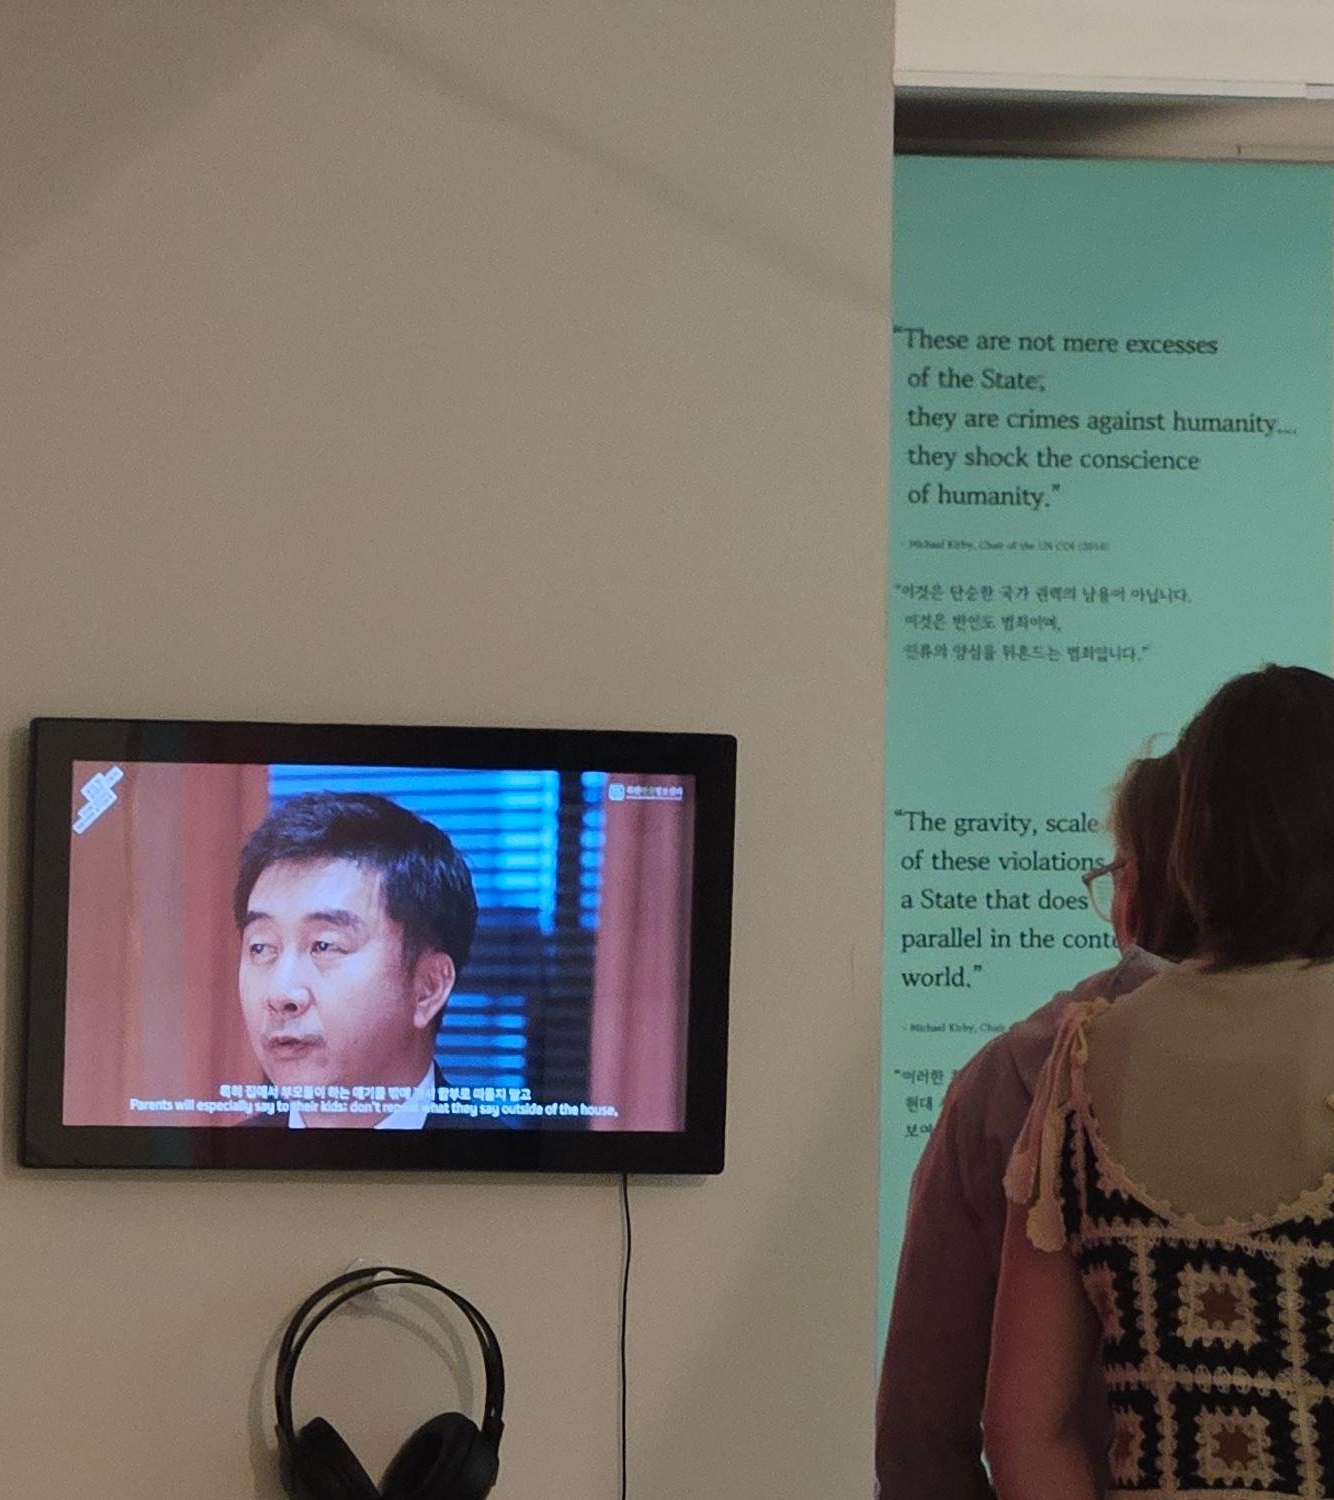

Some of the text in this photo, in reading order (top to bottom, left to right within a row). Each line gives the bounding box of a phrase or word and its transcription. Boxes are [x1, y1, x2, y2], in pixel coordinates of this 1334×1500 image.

[976, 334, 1012, 351] are
[1018, 333, 1056, 351] not
[1063, 337, 1119, 353] mere
[1125, 338, 1219, 355] excesses
[907, 365, 932, 388] of
[937, 367, 975, 389] the
[907, 406, 957, 430] they
[964, 412, 1000, 428] are
[1006, 409, 1081, 429] crimes
[1087, 412, 1165, 435] against
[907, 444, 1201, 470] they shock the conscience
[907, 482, 932, 504] of
[953, 813, 1039, 838] gravity,
[1045, 811, 1099, 833] scale
[901, 849, 1105, 873] of these violations
[901, 888, 1089, 910] a State that does
[901, 927, 983, 953] parallel
[990, 928, 1011, 948] in
[1019, 927, 1055, 948] the
[129, 1098, 173, 1111] Parents
[175, 1098, 194, 1111] will
[196, 1098, 253, 1114] especially
[254, 1101, 275, 1115] say
[276, 1101, 289, 1112] to
[290, 1100, 318, 1113] their
[320, 1100, 348, 1113] kids:
[451, 1102, 477, 1117] they
[479, 1104, 501, 1118] say
[501, 1103, 543, 1115] outside
[545, 1102, 559, 1115] of
[560, 1103, 578, 1116] the
[580, 1104, 619, 1117] house.
